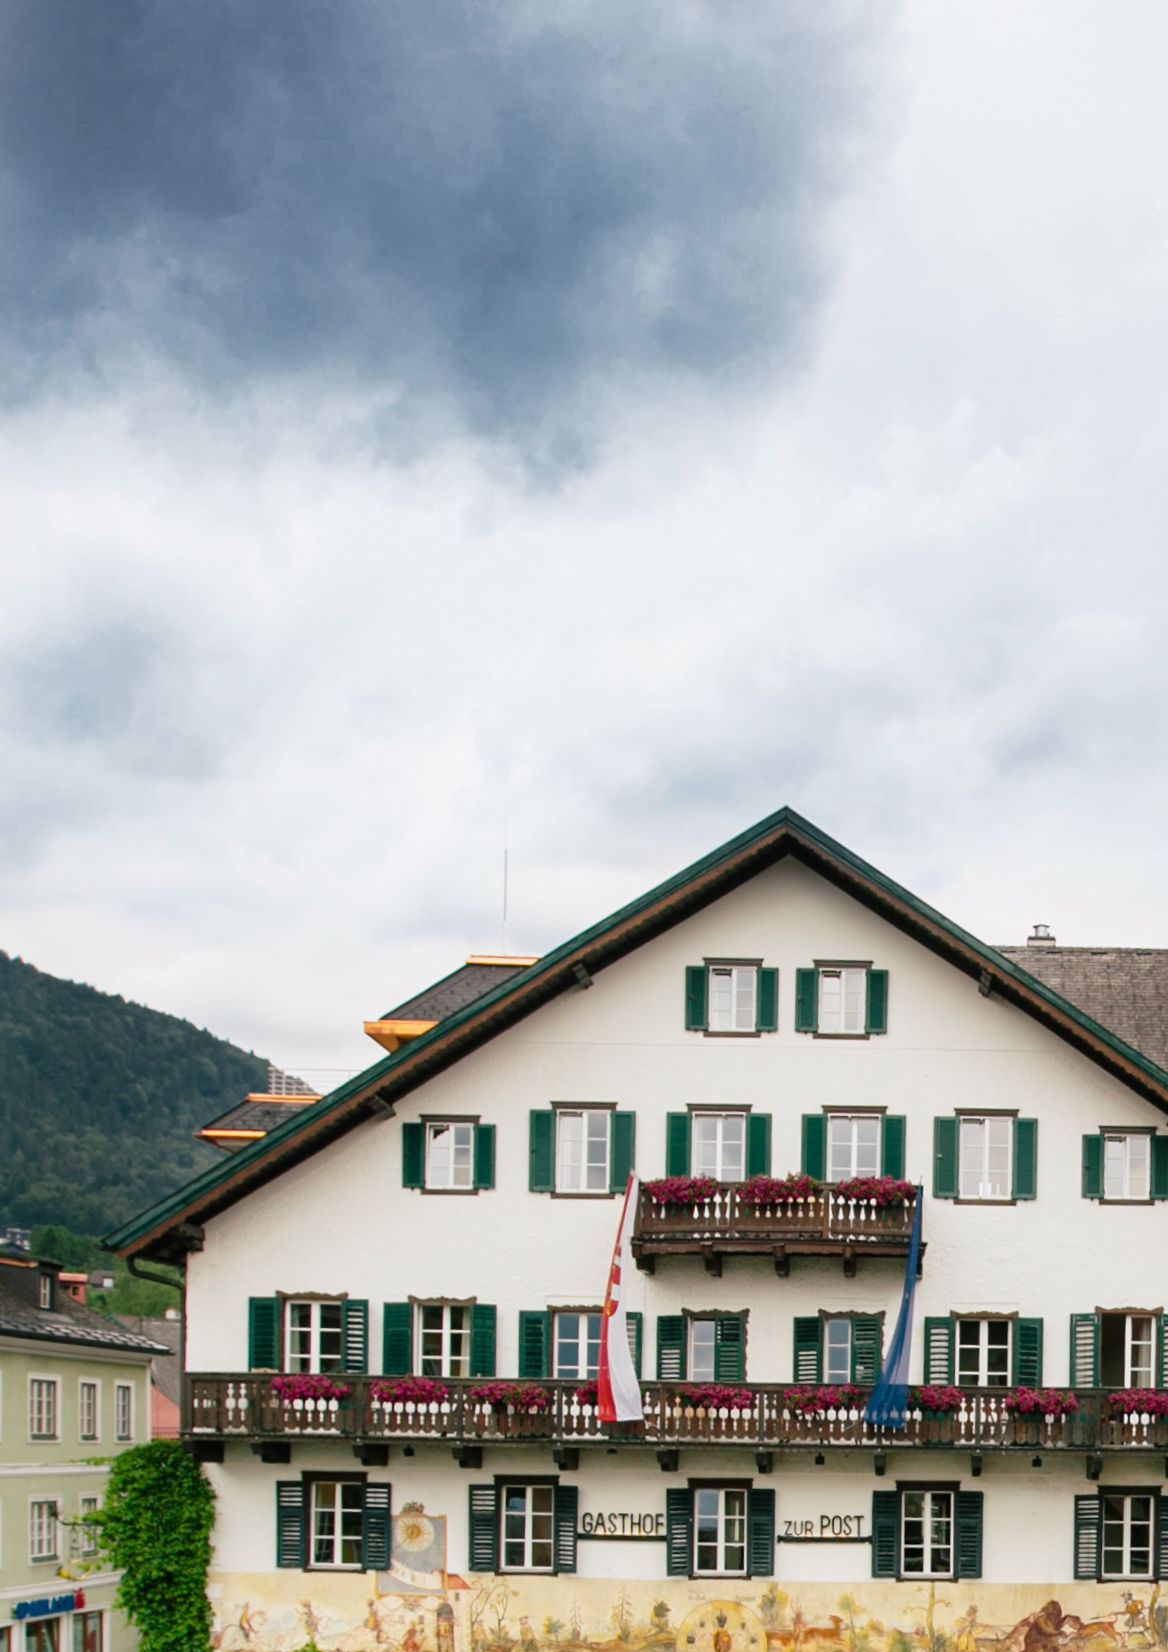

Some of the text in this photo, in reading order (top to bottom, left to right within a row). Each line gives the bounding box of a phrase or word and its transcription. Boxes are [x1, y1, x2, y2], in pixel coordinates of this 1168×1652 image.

[581, 1512, 865, 1537] GASTHOF ZUR POST
